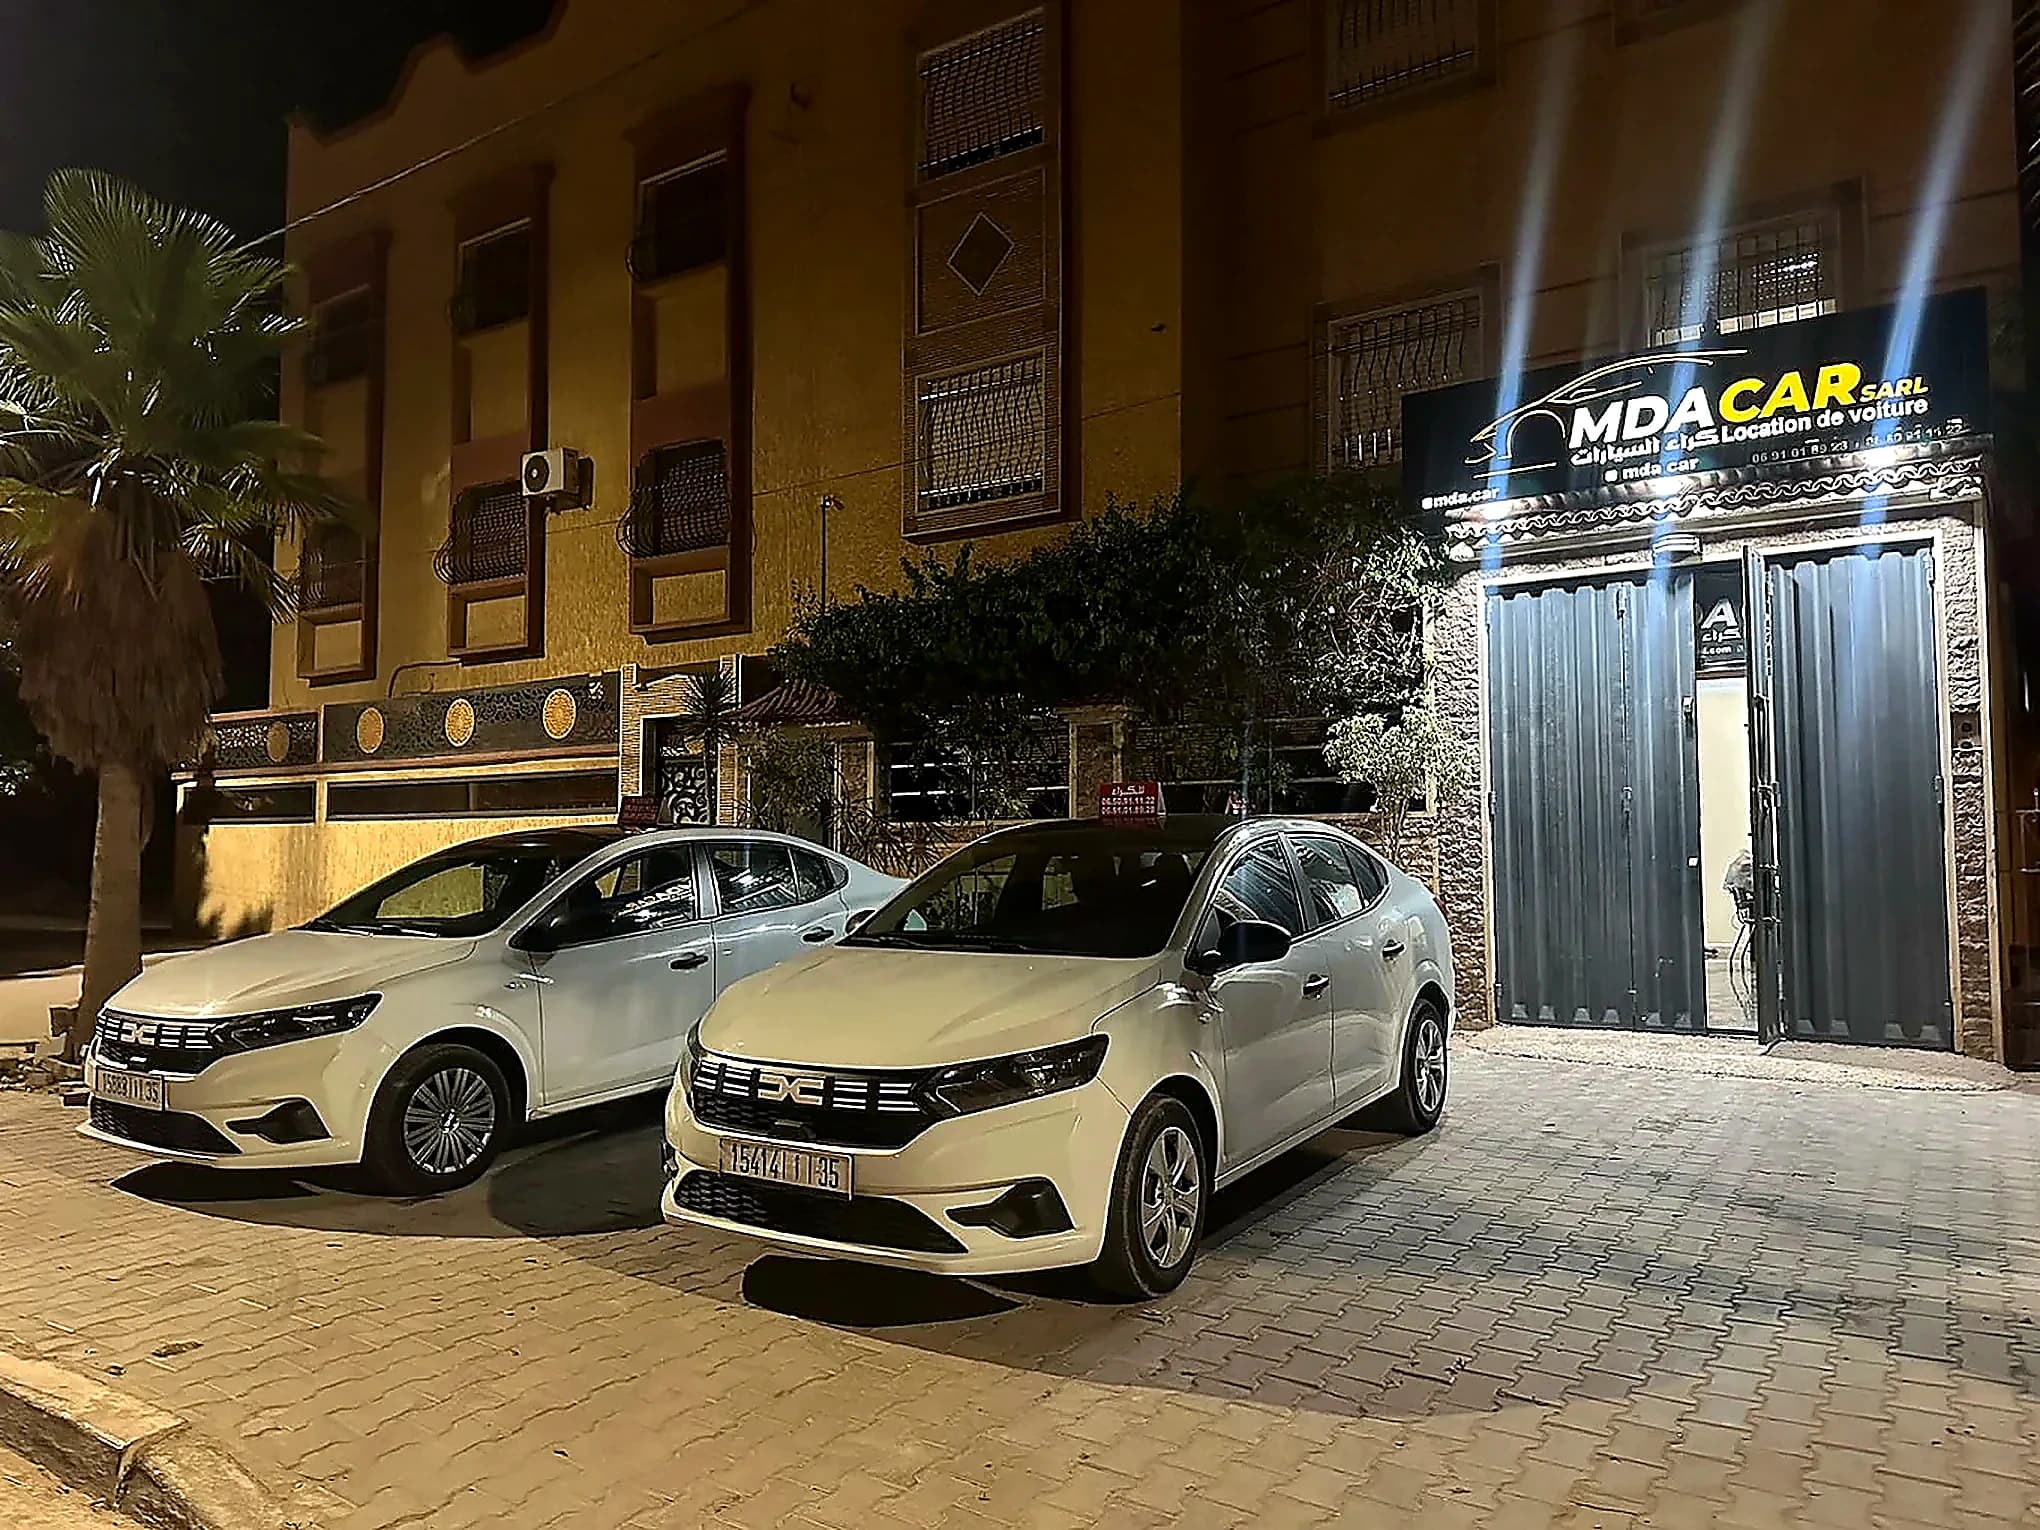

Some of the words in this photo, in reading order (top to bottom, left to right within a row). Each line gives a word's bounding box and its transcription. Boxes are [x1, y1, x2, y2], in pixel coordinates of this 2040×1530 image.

[1569, 387, 1715, 449] MDA
[1719, 363, 1862, 423] CAR
[1859, 377, 1929, 402] SARL
[1722, 416, 1812, 443] Location
[1817, 408, 1845, 428] de
[1850, 398, 1929, 424] voiture
[1570, 437, 1660, 466] السيارات
[1665, 429, 1720, 451] كراء
[1622, 461, 1661, 480] mda
[1666, 457, 1699, 473] car
[732, 1143, 779, 1179] 15414
[817, 1156, 840, 1189] 35
